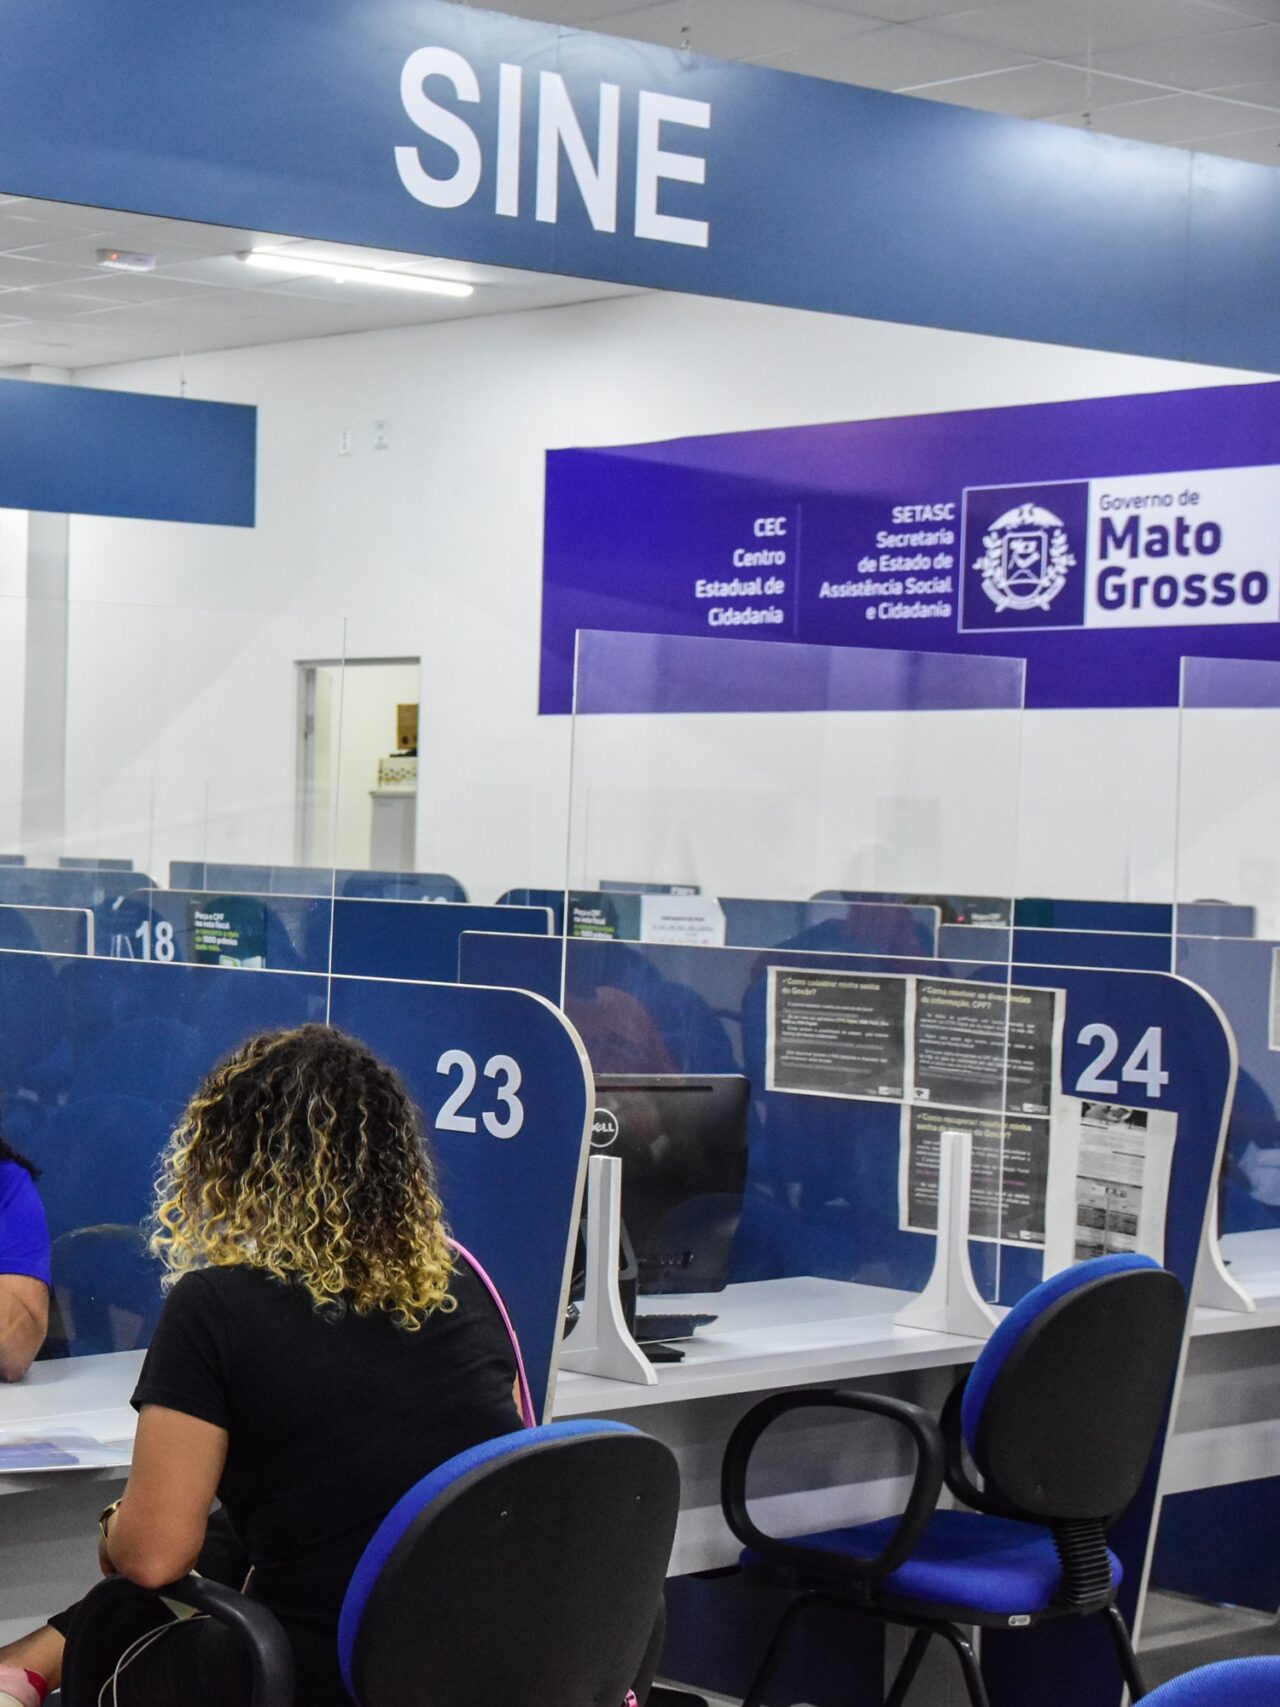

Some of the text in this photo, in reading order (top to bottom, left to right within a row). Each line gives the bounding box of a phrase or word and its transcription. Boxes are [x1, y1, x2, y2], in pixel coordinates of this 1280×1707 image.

[394, 46, 711, 248] SINE
[1099, 489, 1200, 511] Governo de
[892, 502, 955, 524] SETASC
[753, 516, 787, 537] CEC
[876, 527, 955, 548] Secretaria
[1098, 515, 1222, 561] Mato
[732, 548, 786, 567] Centro
[857, 551, 954, 573] de Estado de
[695, 576, 785, 598] Estadual de
[819, 576, 953, 598] Assistência Social
[1097, 565, 1269, 611] Grosso
[708, 605, 784, 626] Cidadania
[865, 600, 951, 620] e Cidadania
[136, 921, 175, 962] 18
[1075, 1023, 1169, 1098] 24
[435, 1049, 524, 1139] 23
[591, 1122, 615, 1132] ELL
